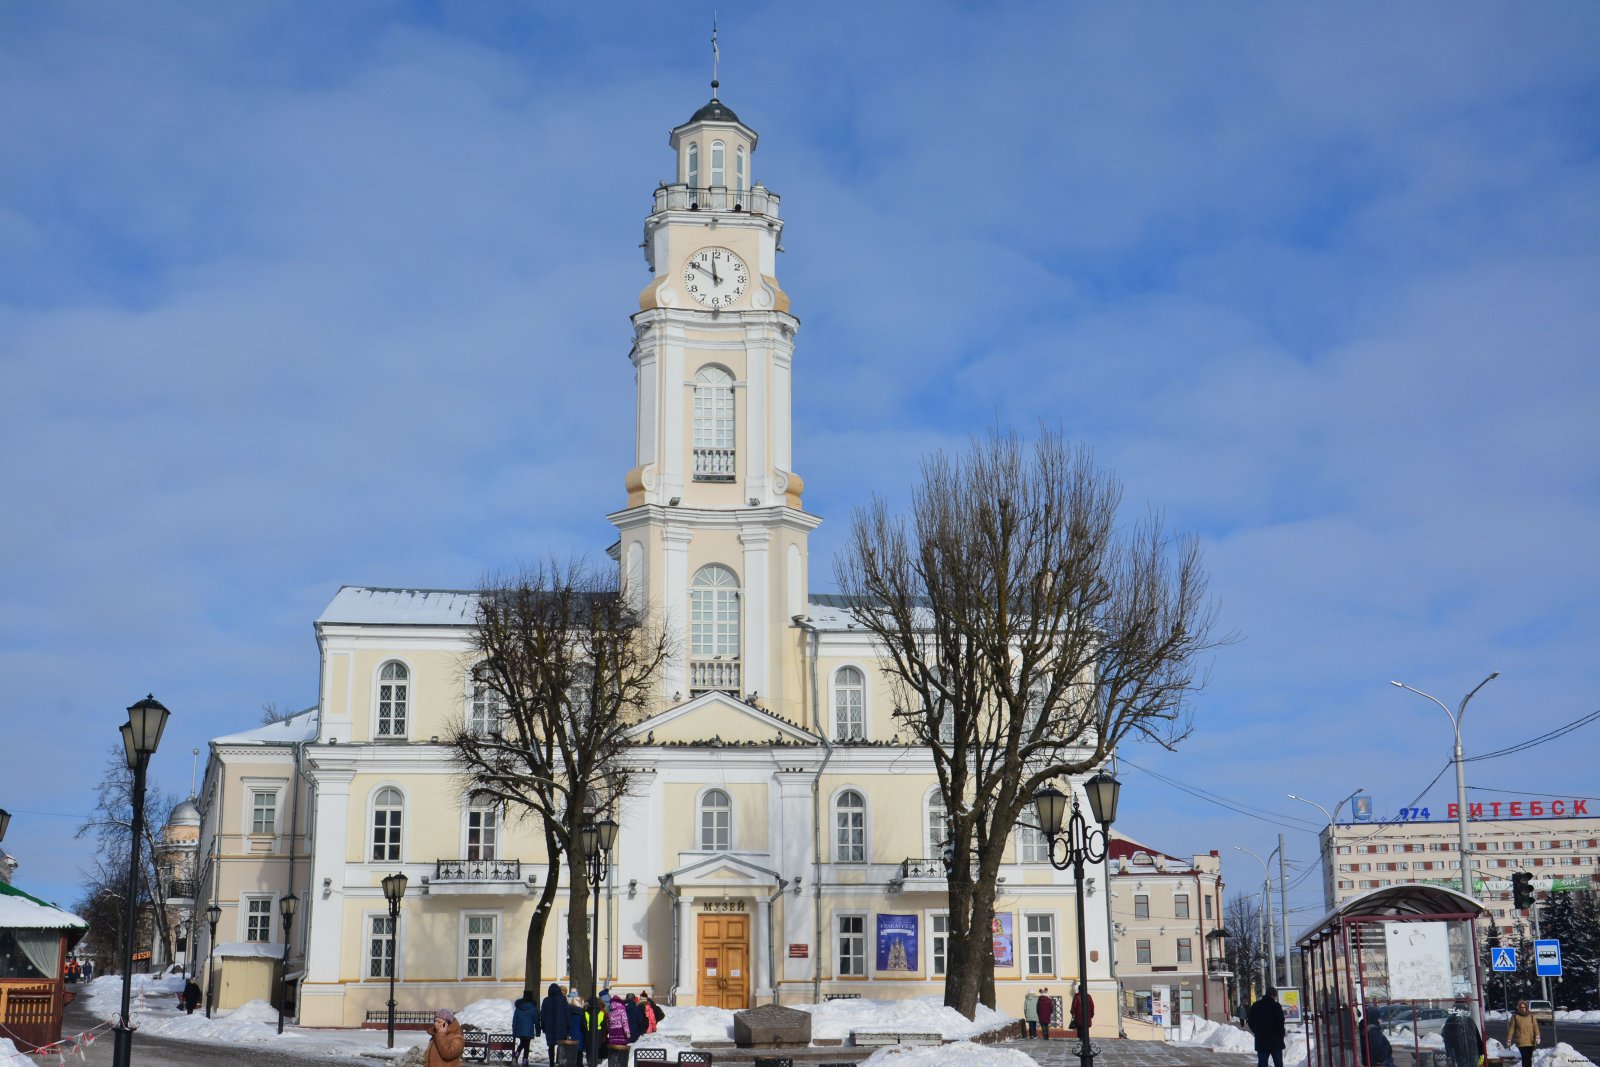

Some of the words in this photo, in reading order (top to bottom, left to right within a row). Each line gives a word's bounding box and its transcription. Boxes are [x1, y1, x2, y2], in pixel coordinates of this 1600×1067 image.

[734, 263, 741, 271] 2
[687, 273, 695, 281] 9
[700, 293, 706, 301] 7
[1399, 807, 1430, 819] 974
[1447, 799, 1588, 818] ВИТЕБСК
[703, 899, 745, 911] МУЗЕЙ
